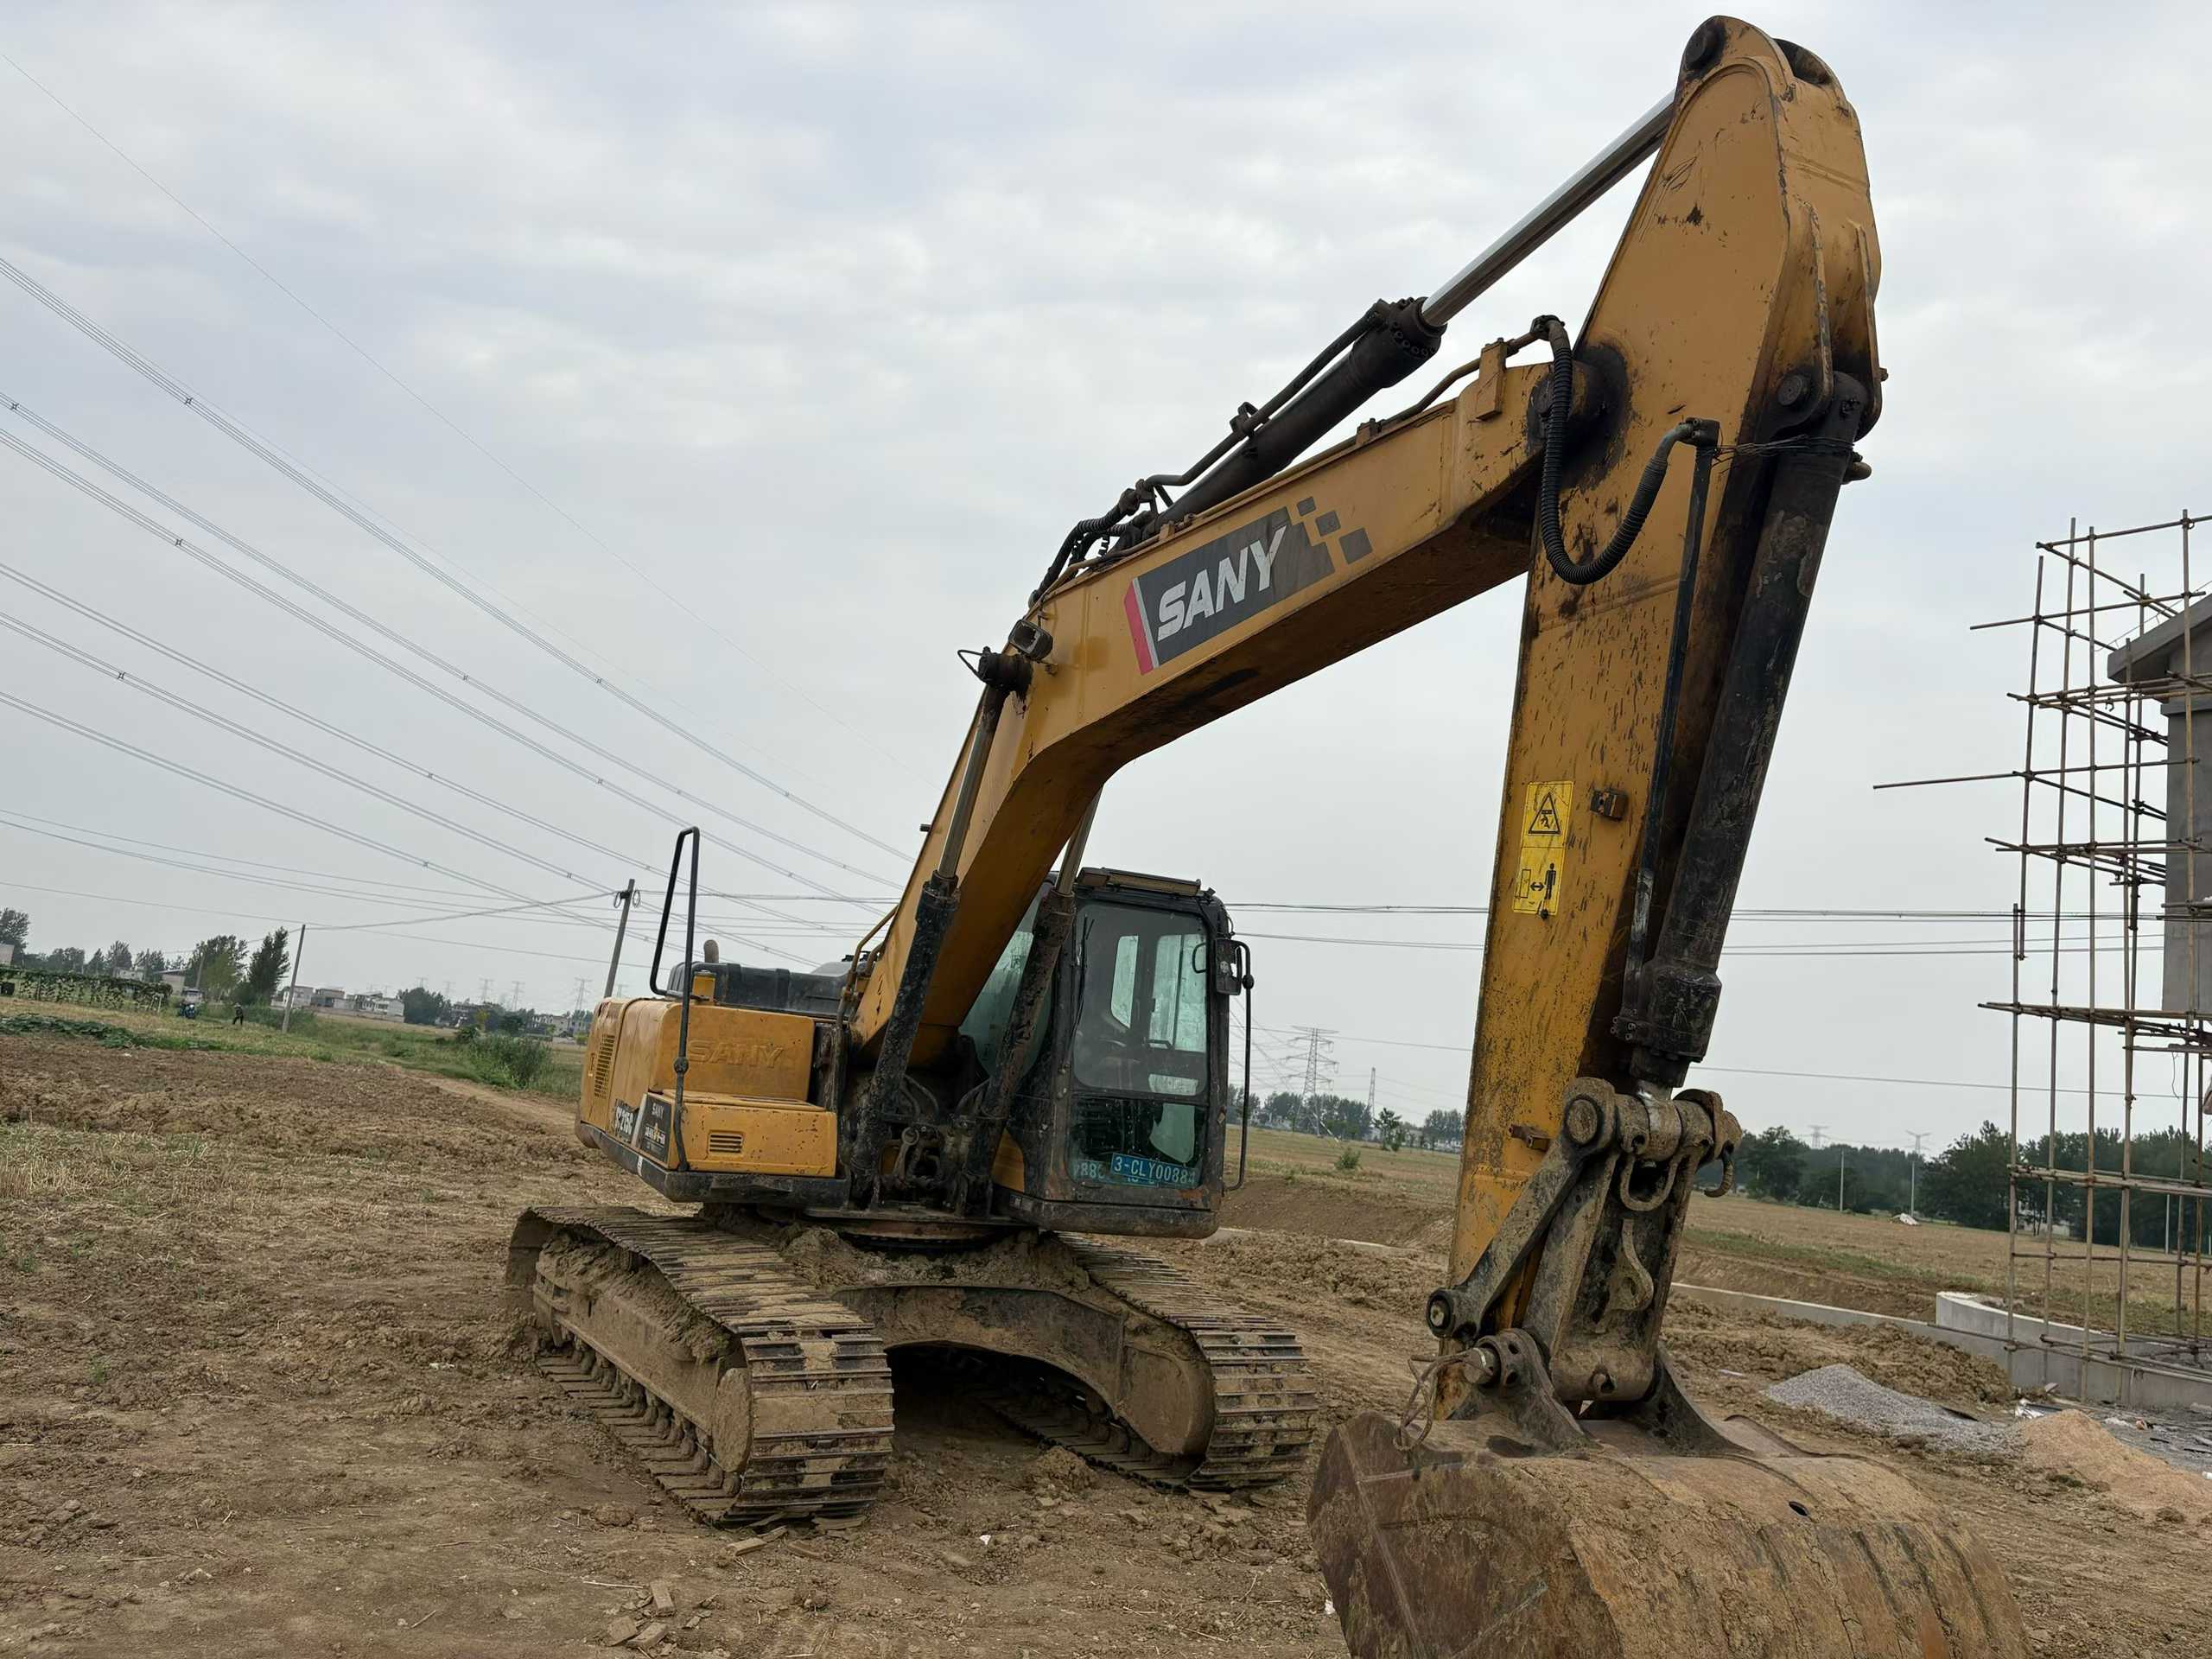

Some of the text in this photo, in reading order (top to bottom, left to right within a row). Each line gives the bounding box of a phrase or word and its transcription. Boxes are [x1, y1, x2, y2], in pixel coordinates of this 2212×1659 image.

[1158, 524, 1287, 642] SANY
[689, 1039, 785, 1069] SANY
[652, 1103, 664, 1120] SANY
